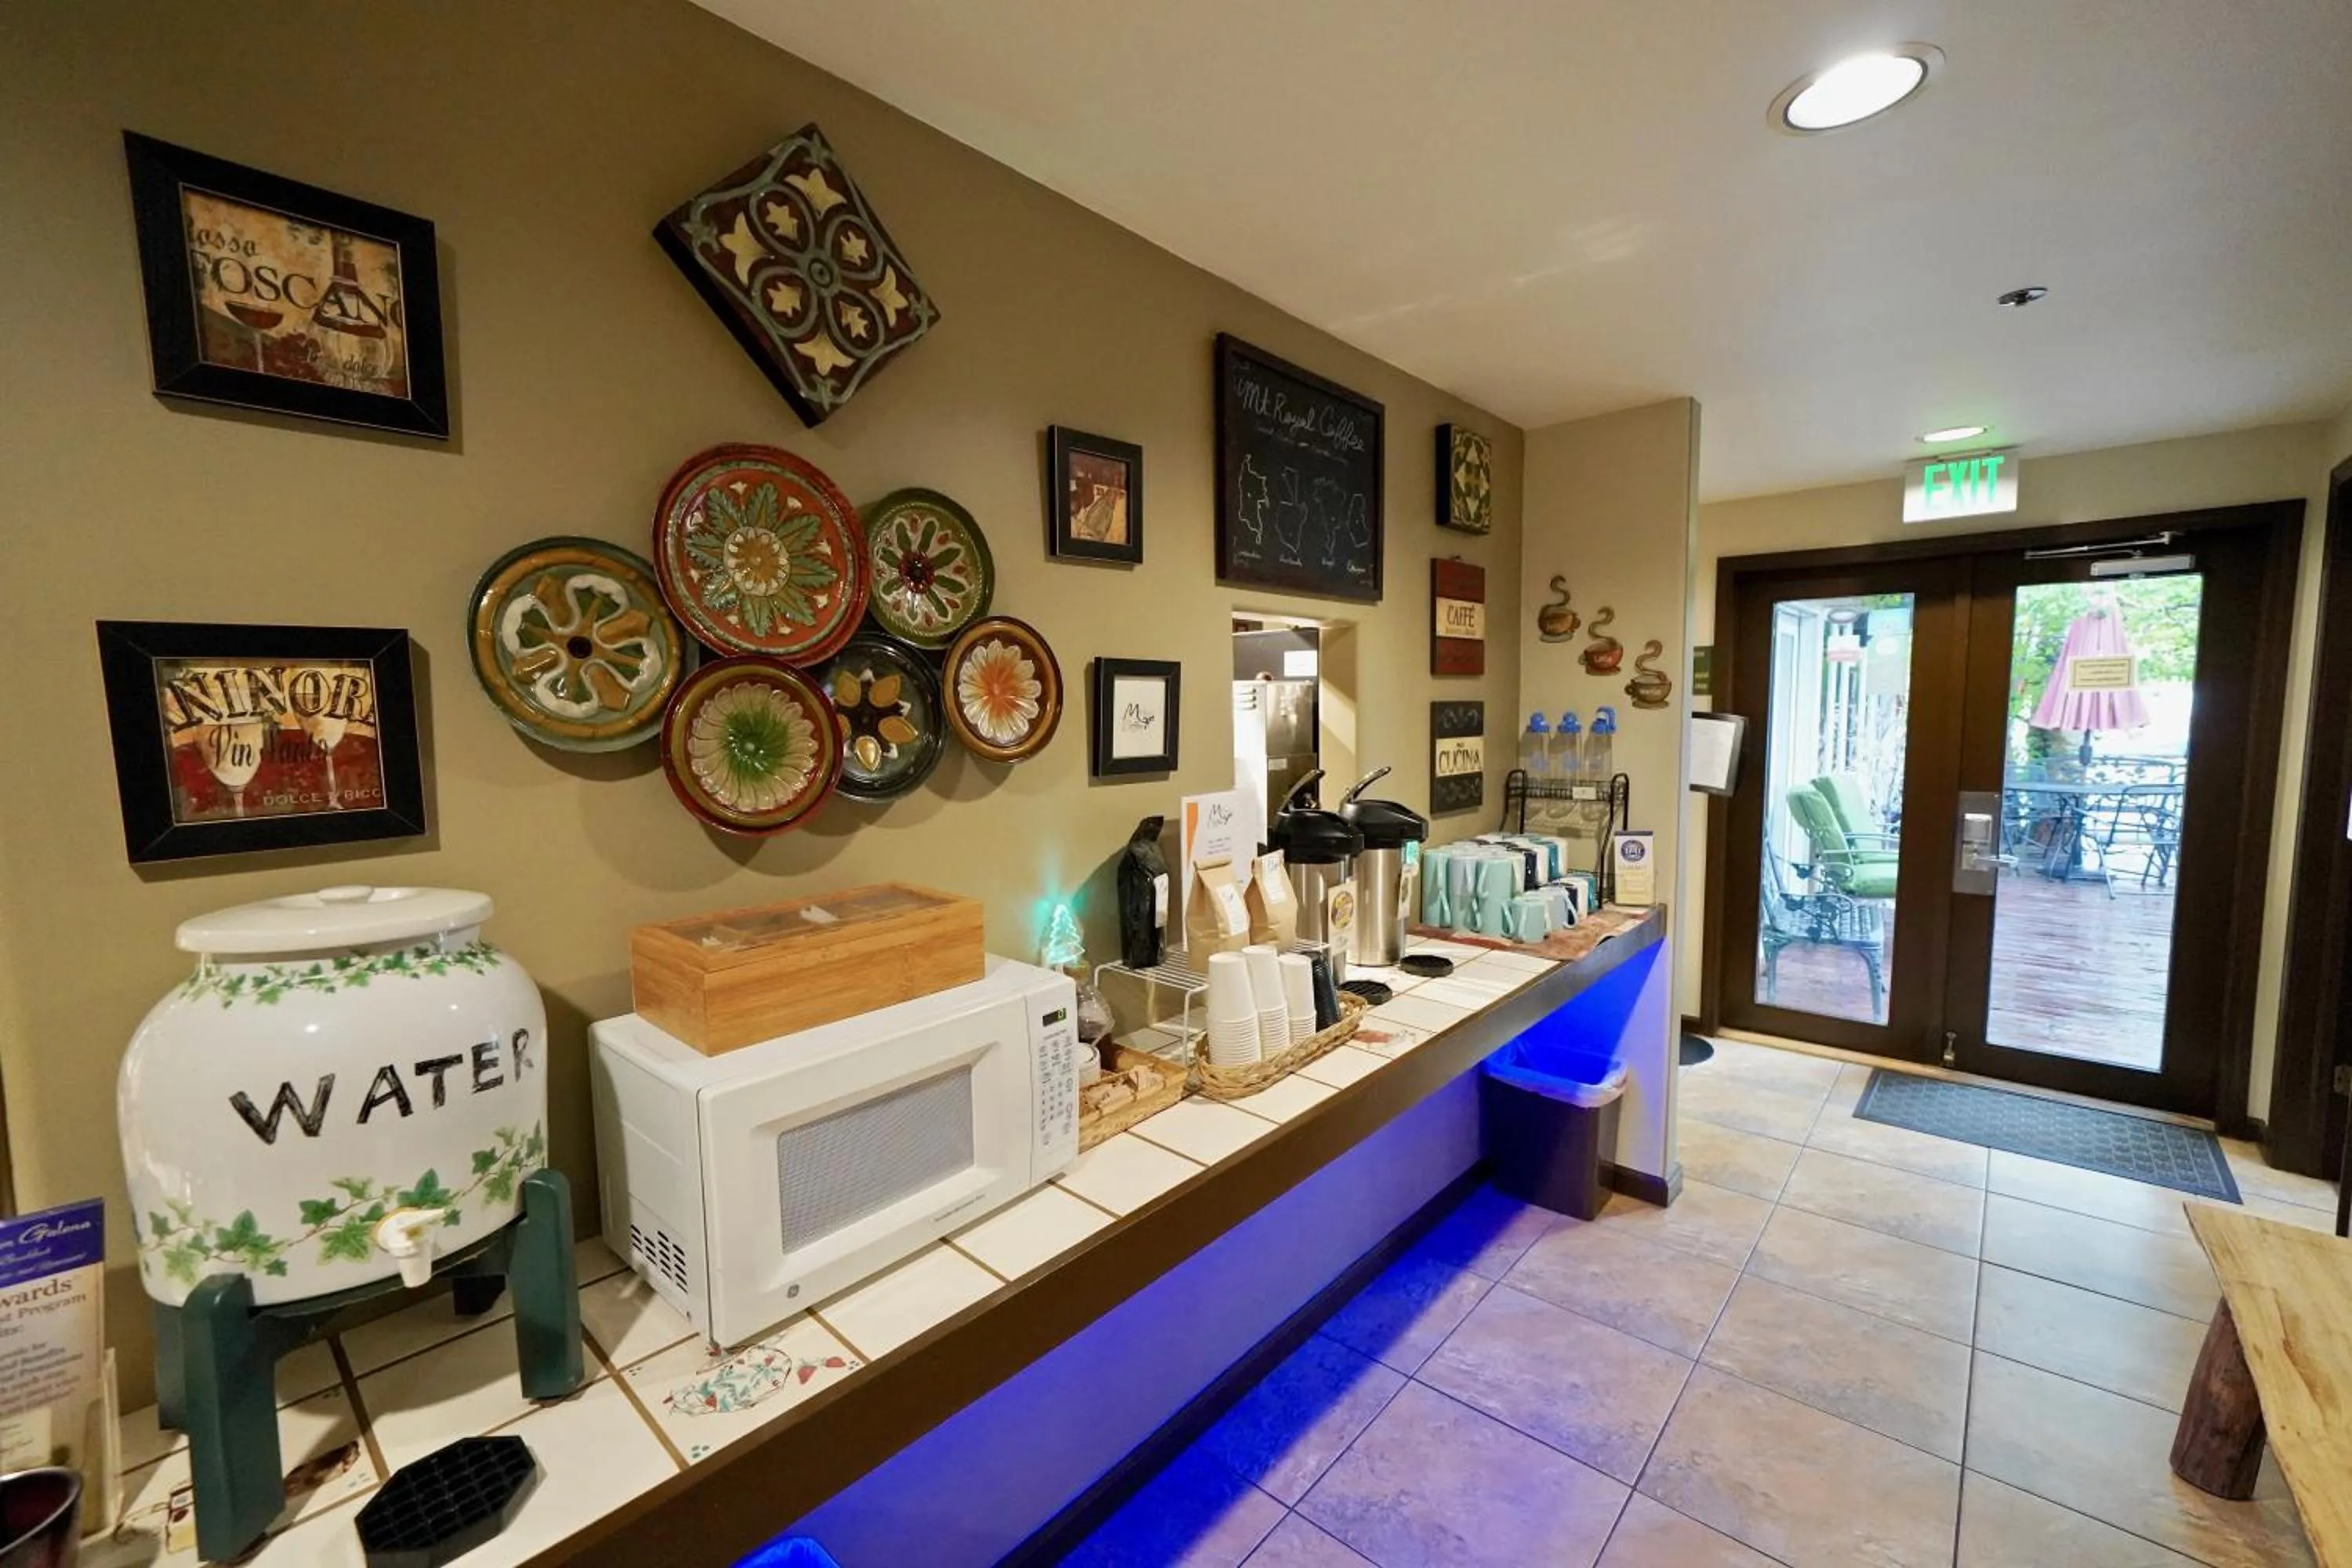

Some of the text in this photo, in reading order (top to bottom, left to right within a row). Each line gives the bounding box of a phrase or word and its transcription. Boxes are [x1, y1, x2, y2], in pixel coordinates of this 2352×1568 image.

[1924, 456, 2004, 510] EXIT
[1439, 749, 1482, 773] CUCINA
[229, 1027, 534, 1145] WATER
